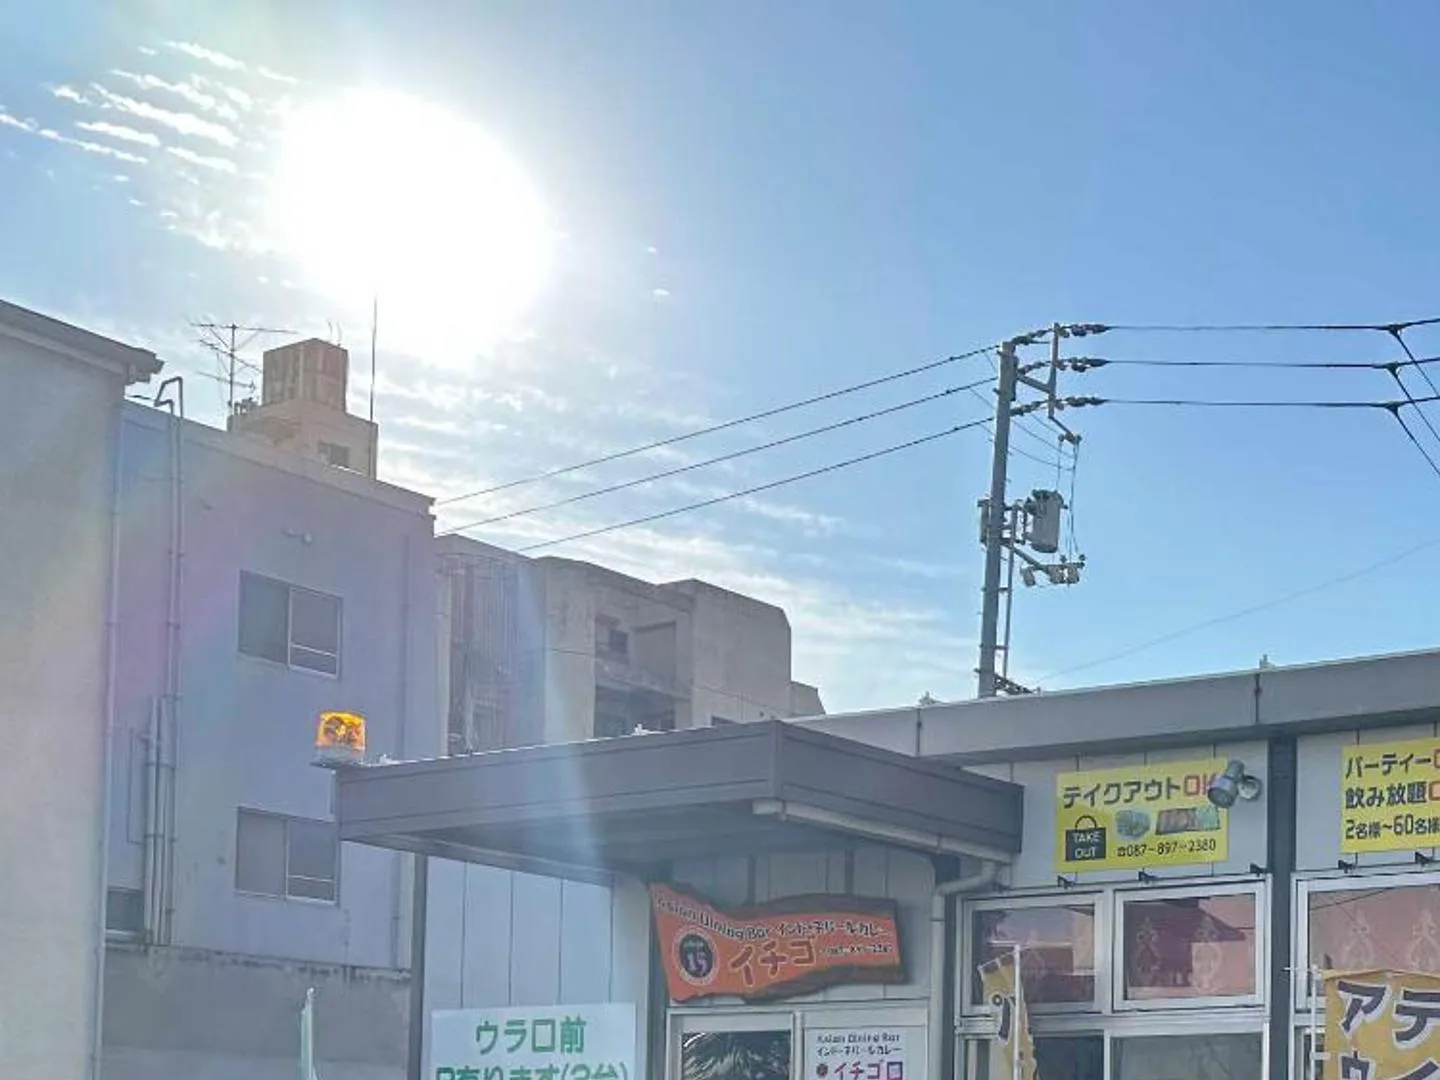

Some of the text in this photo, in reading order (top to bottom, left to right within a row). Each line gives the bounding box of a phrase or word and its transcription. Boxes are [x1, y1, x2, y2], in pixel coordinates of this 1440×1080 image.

[1073, 830, 1101, 842] TAKE
[1074, 847, 1097, 859] OUT
[730, 936, 817, 987] イチゴ
